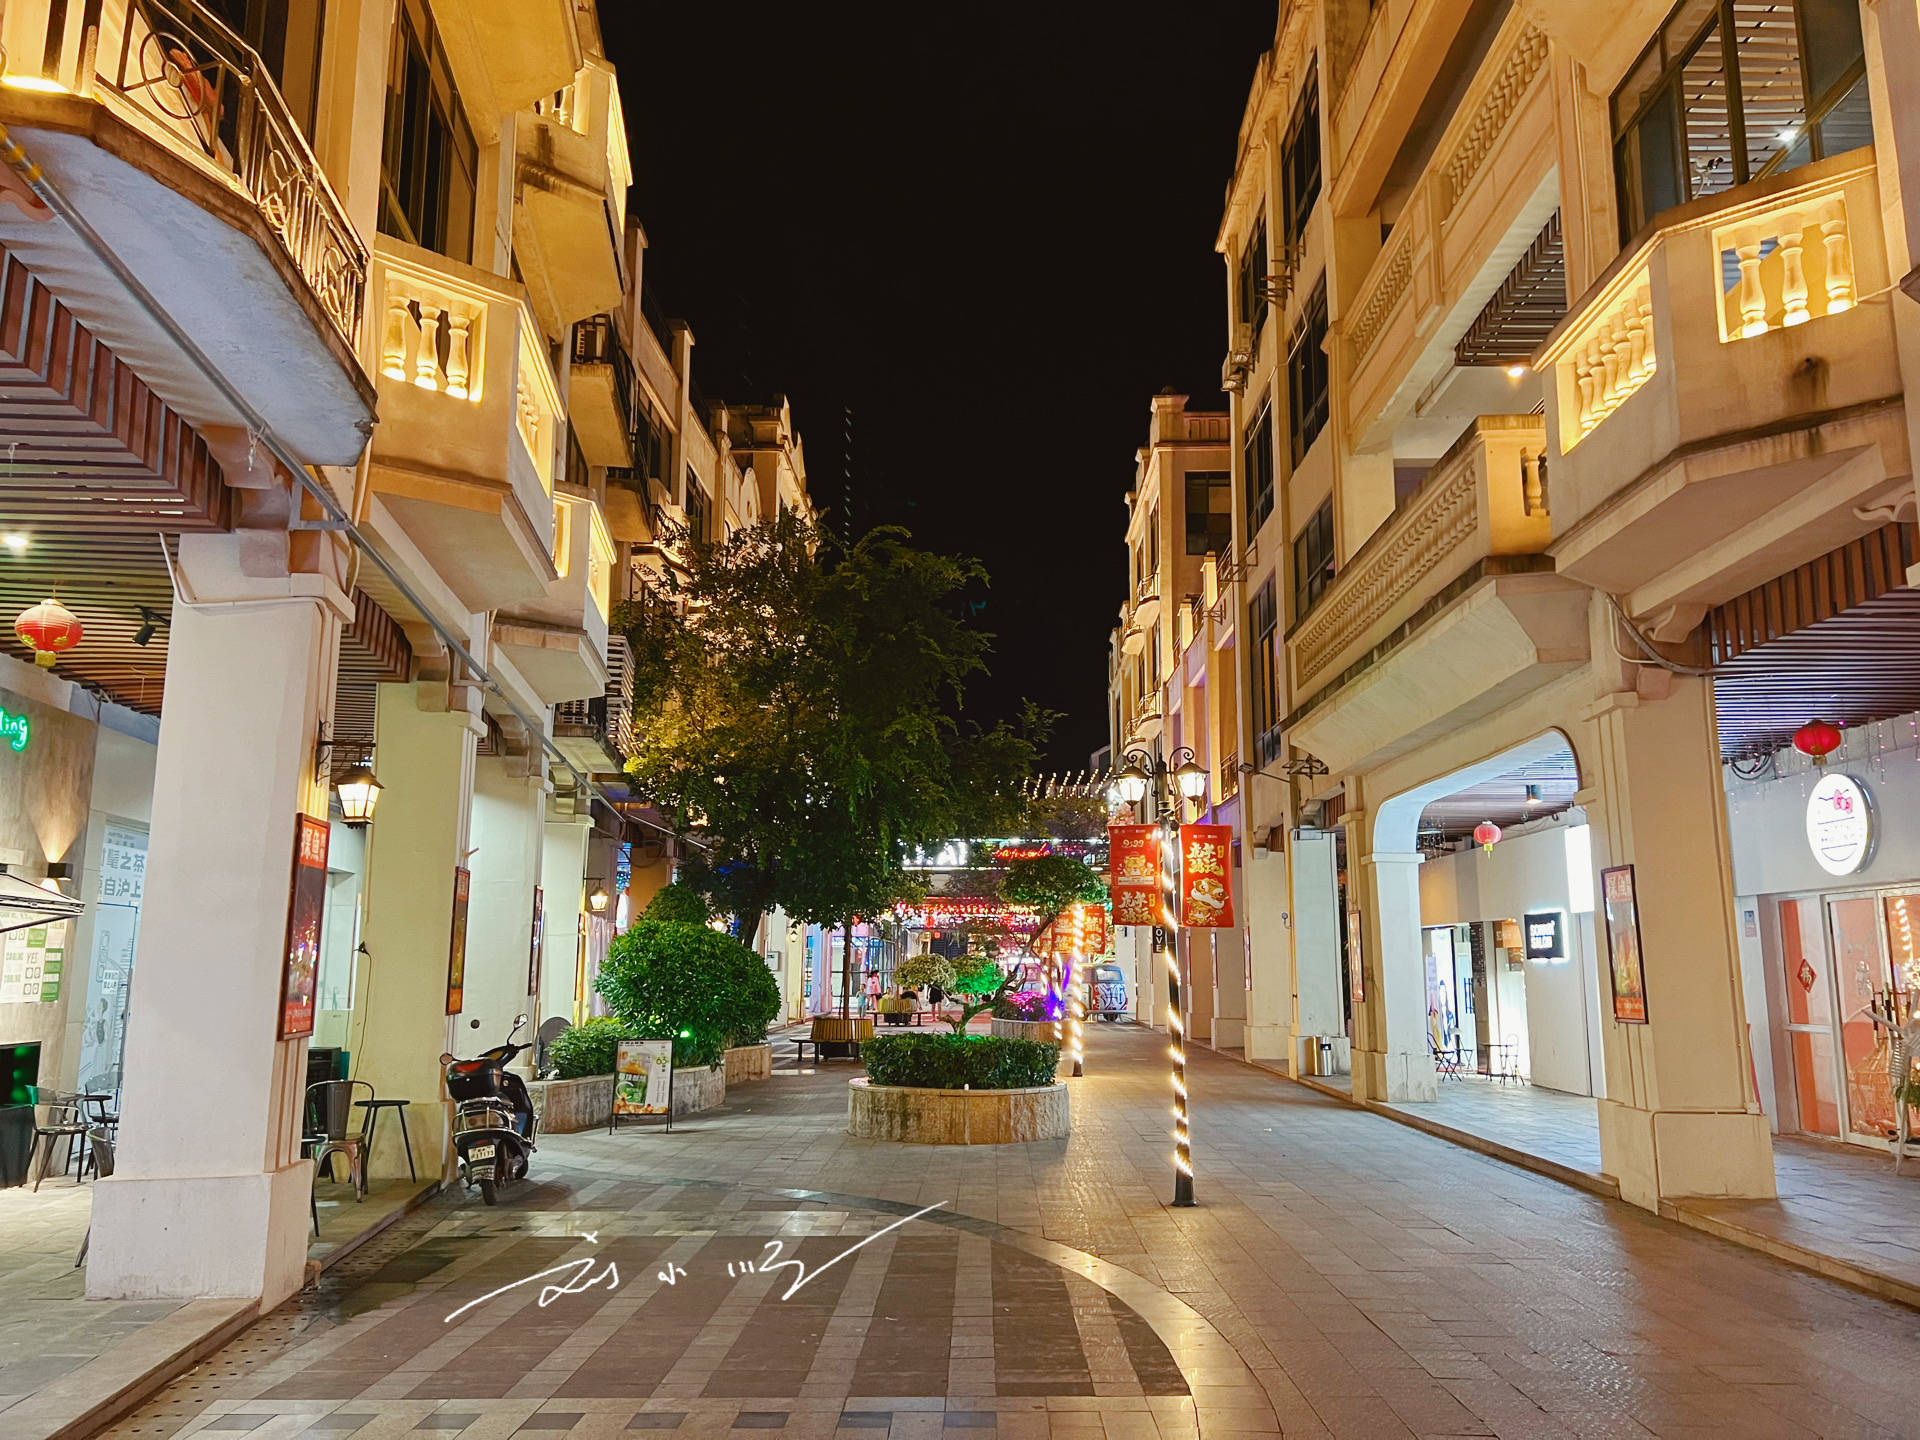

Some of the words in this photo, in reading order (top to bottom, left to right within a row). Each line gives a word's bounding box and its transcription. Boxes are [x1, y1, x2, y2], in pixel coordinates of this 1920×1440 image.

[102, 847, 145, 873] 髦之茶
[98, 874, 142, 898] 自沪上
[1155, 926, 1163, 952] OVE
